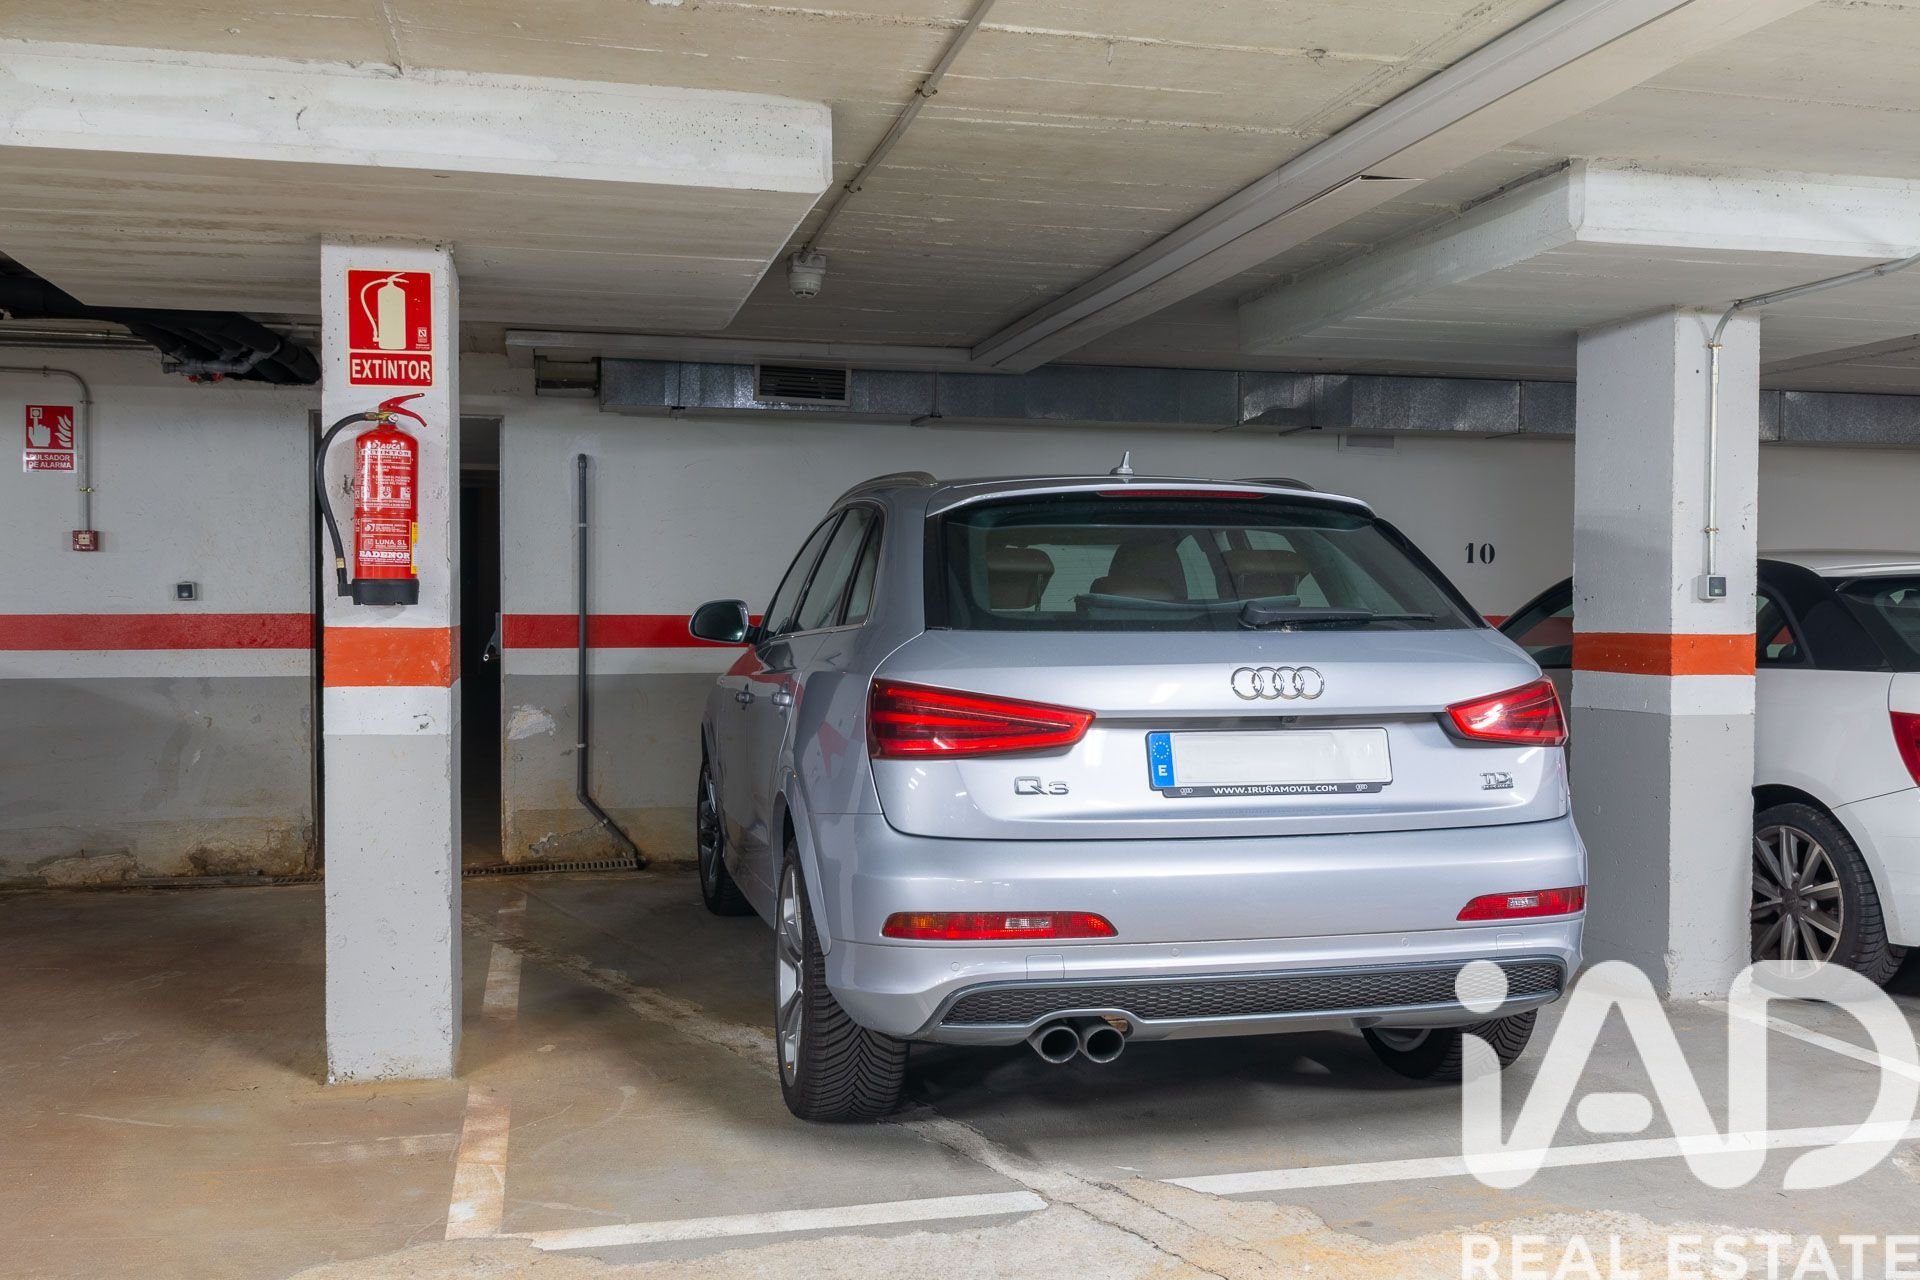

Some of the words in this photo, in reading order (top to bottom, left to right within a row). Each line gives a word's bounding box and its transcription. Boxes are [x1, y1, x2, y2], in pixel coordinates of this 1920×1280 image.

[351, 358, 431, 380] EXTINTOR
[28, 461, 39, 469] DE
[1465, 542, 1496, 565] 10
[1158, 765, 1168, 776] E
[1014, 775, 1070, 796] Q3
[1212, 784, 1338, 795] WWW.IRUÑAMOVIL.COM
